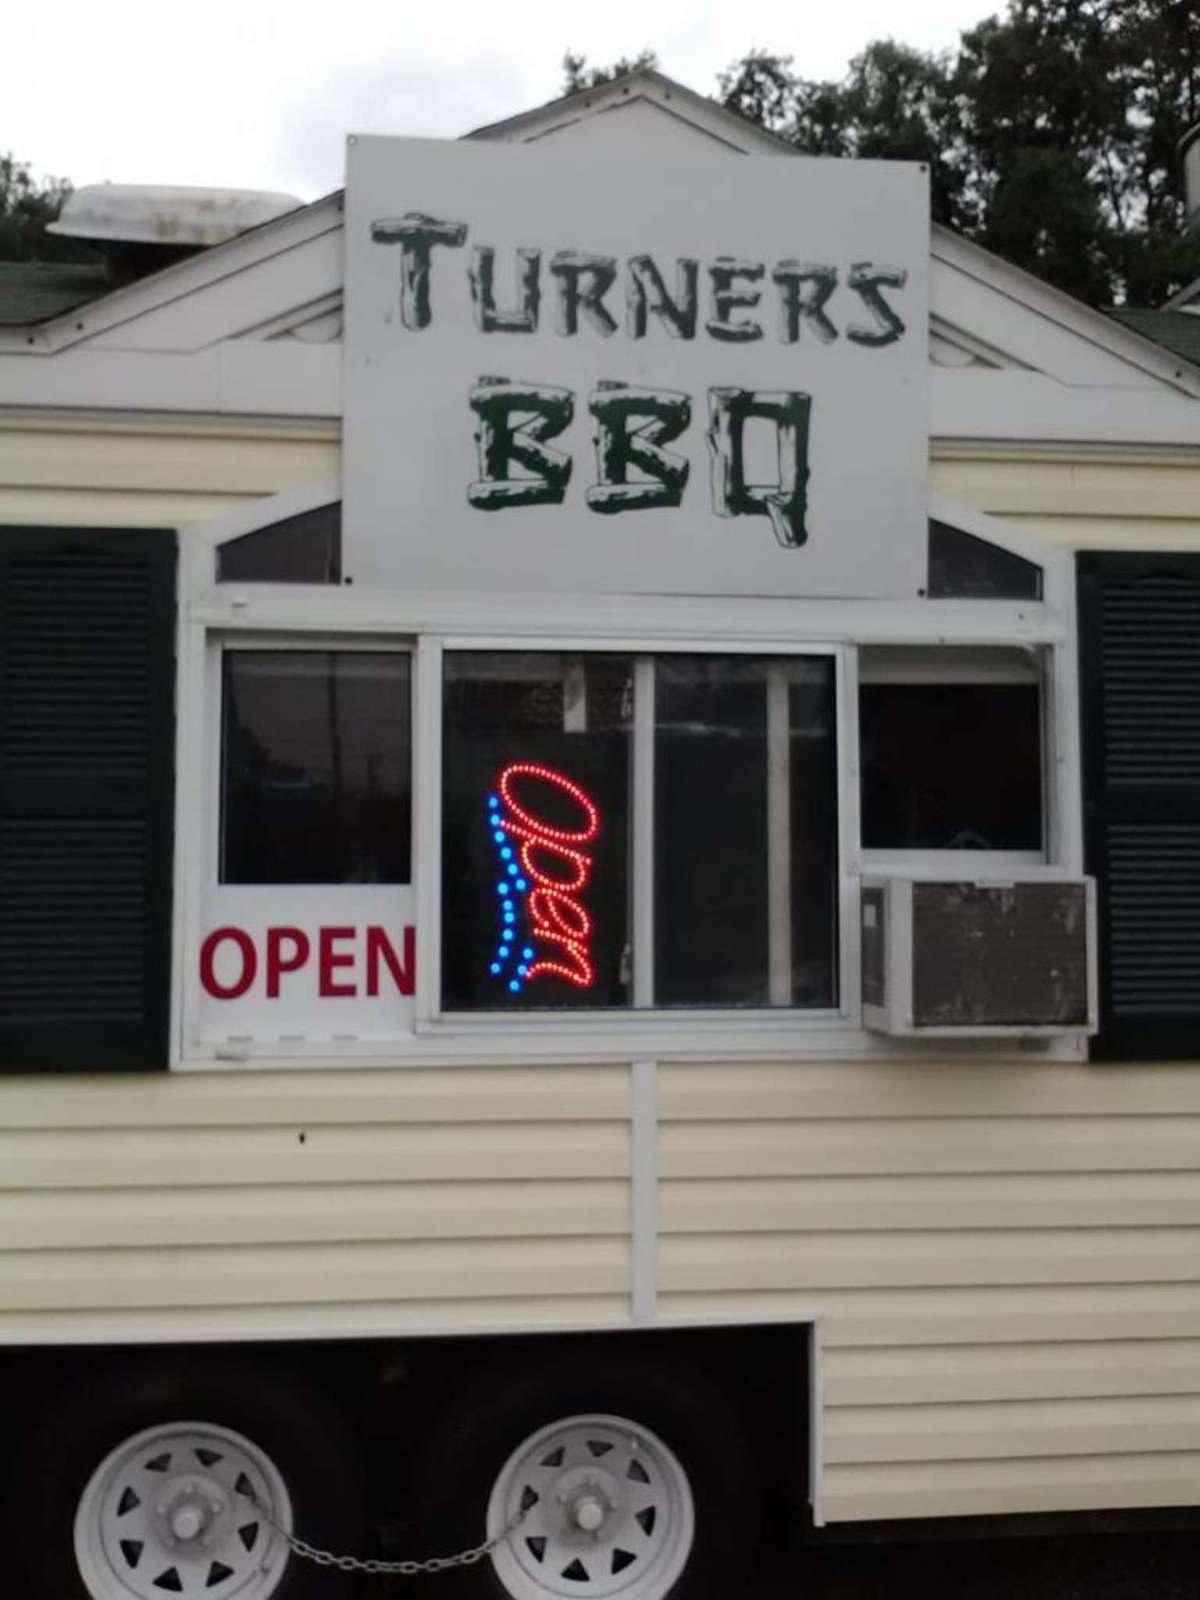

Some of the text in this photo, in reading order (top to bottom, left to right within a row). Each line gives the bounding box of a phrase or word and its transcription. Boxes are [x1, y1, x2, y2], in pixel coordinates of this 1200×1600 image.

[371, 212, 906, 347] TURNERS
[467, 374, 812, 549] BBQ
[200, 925, 416, 1000] OPEN
